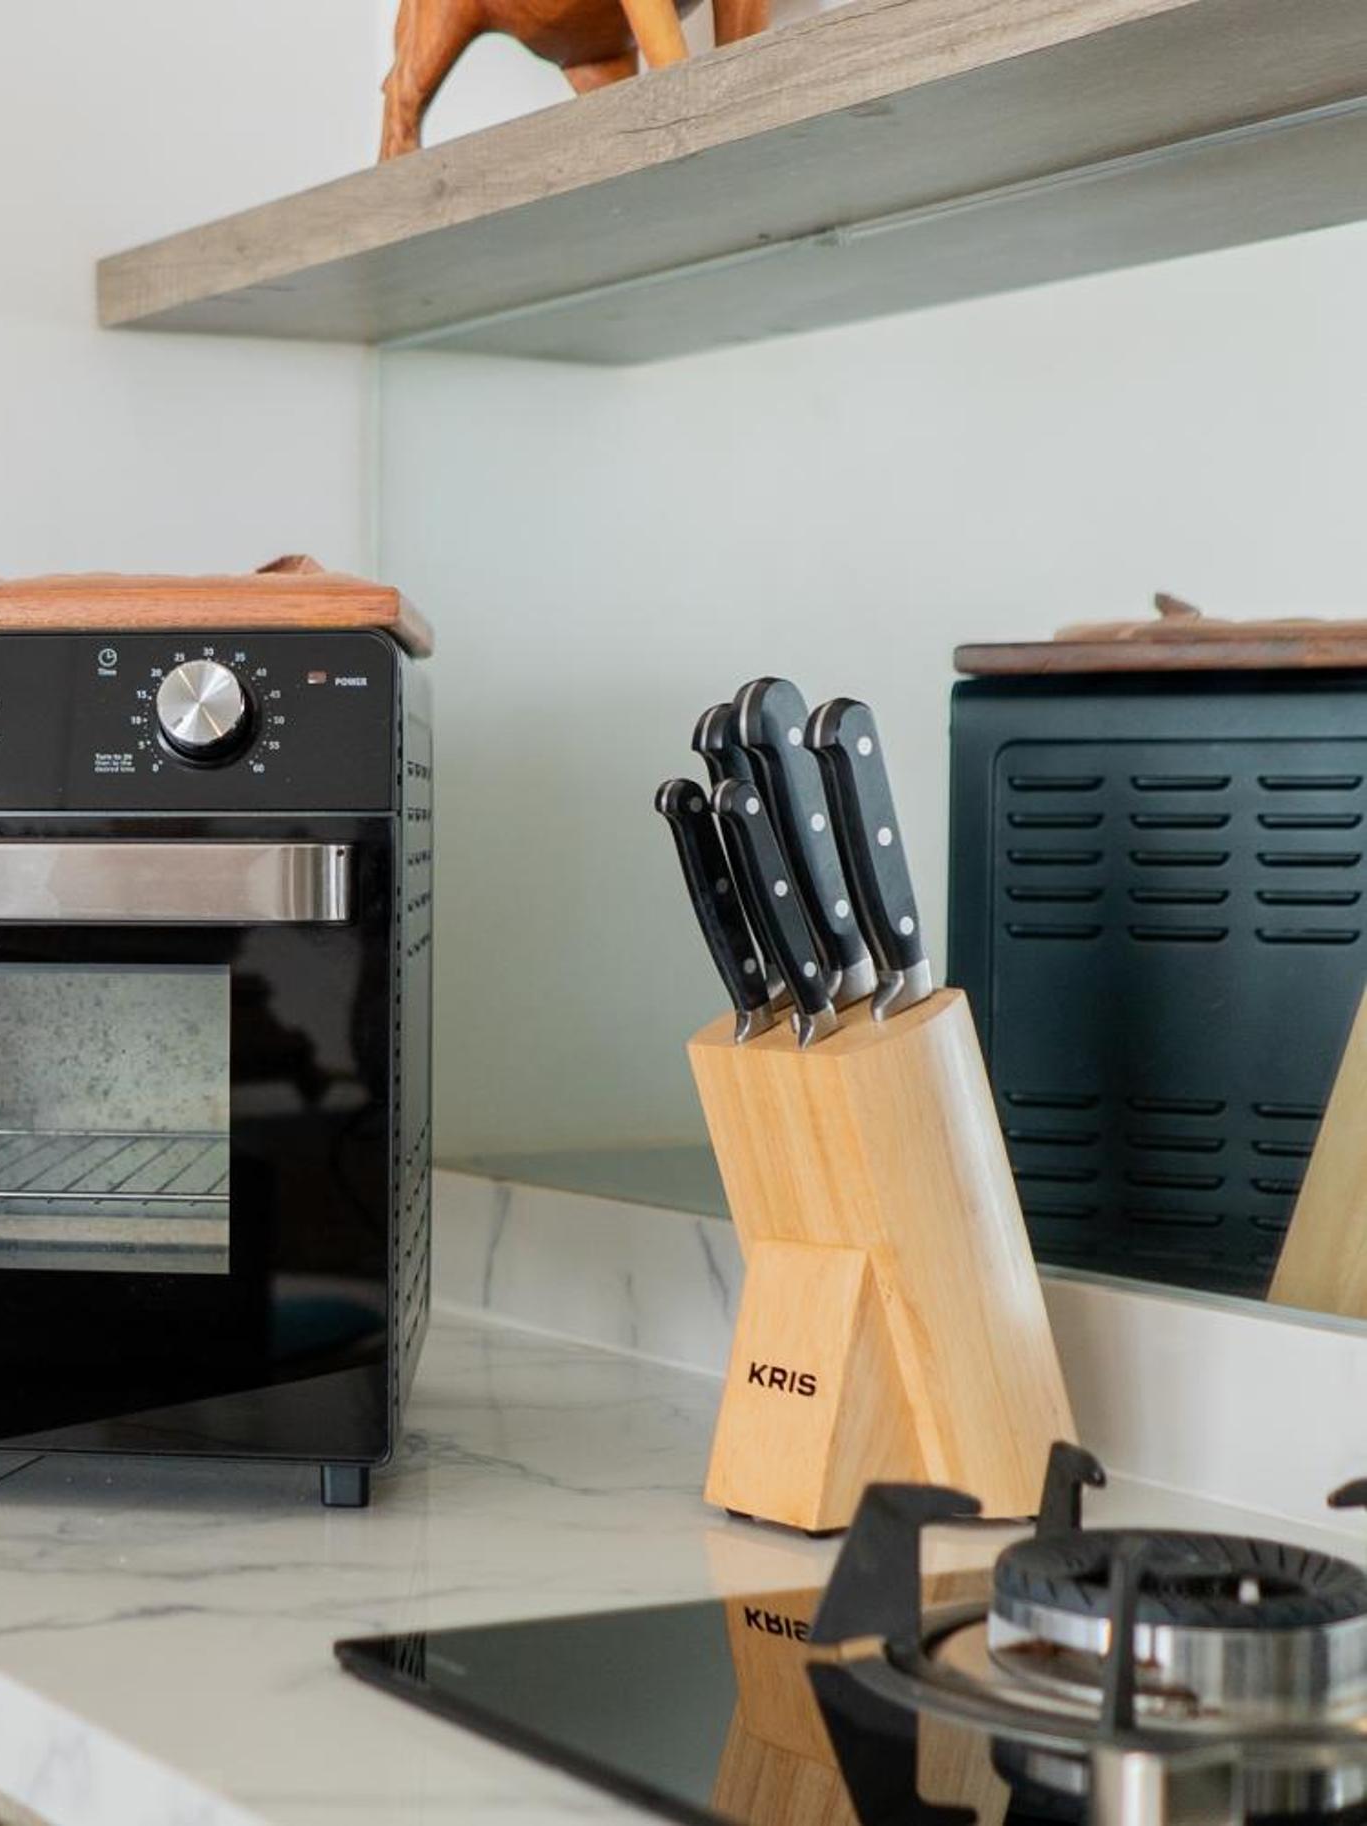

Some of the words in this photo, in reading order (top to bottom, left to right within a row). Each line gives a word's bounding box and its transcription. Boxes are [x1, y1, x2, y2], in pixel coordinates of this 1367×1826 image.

[335, 677, 368, 686] POWER
[136, 690, 147, 699] 15
[269, 741, 281, 750] 55
[253, 763, 265, 773] 60
[747, 1361, 818, 1397] KRIS
